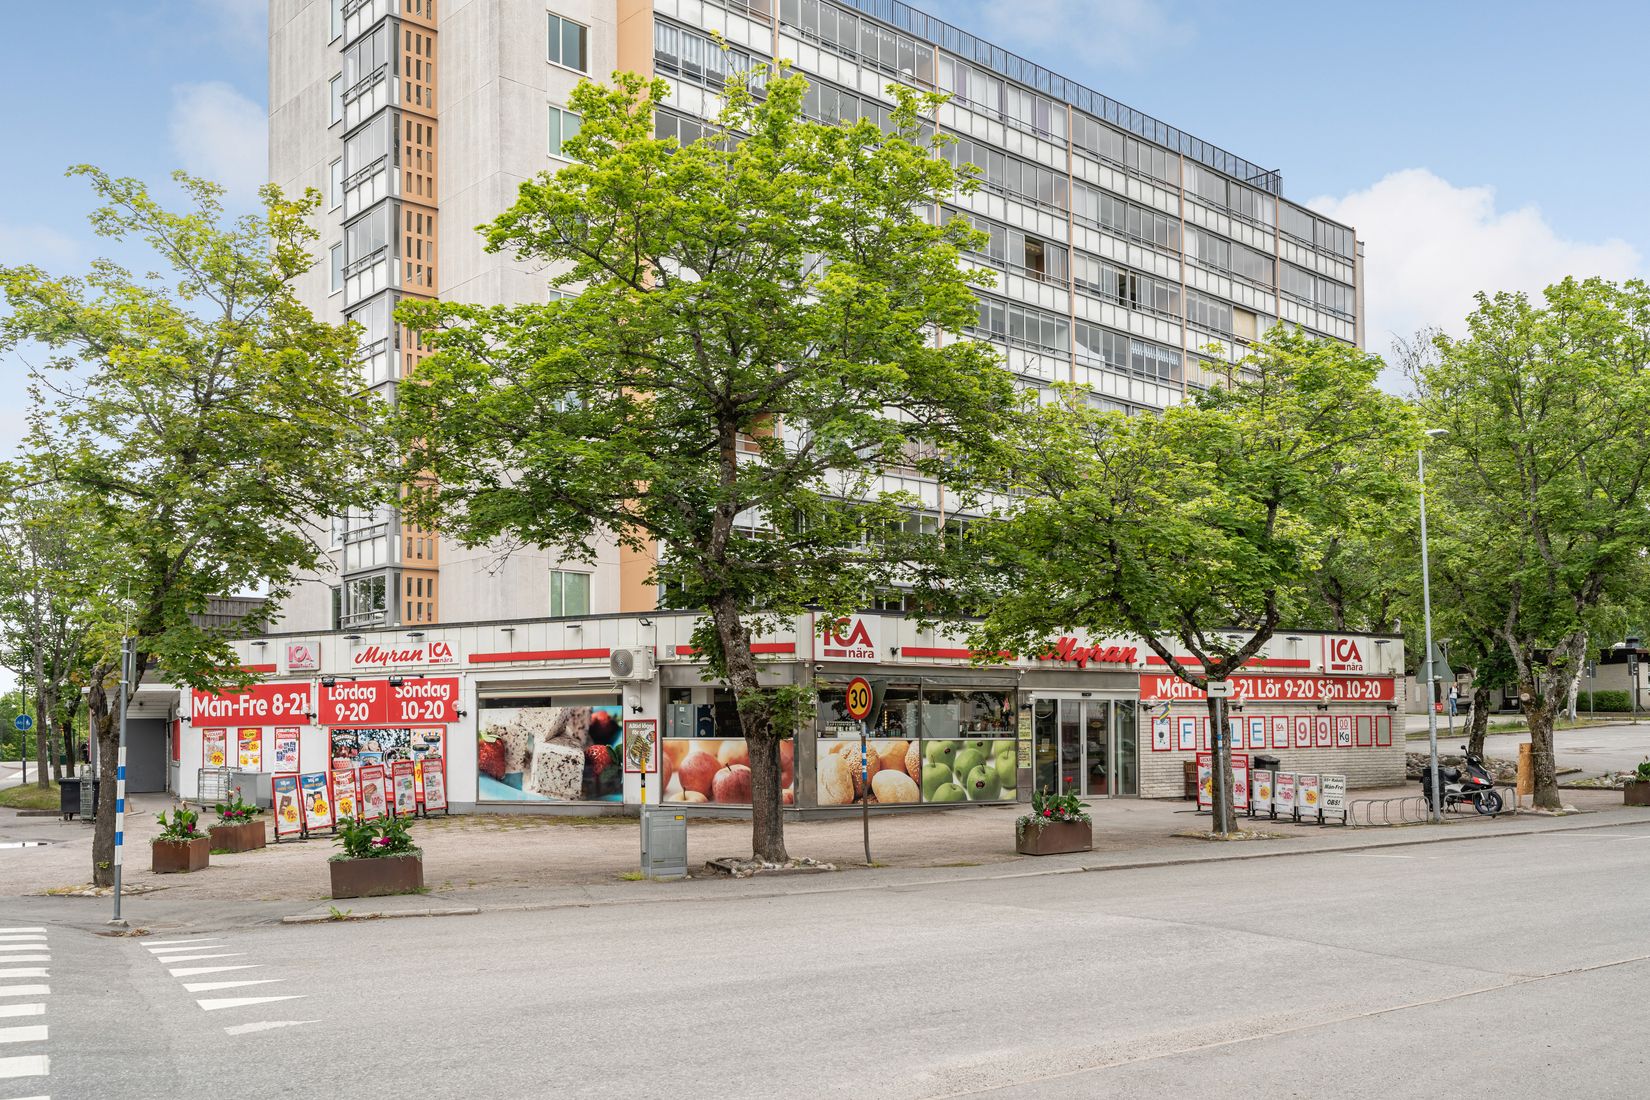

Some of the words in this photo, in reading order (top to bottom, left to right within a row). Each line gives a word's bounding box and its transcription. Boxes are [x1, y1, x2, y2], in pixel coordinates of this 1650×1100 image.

[824, 617, 874, 648] ICA
[288, 646, 313, 663] ICA
[354, 646, 423, 666] Myran
[429, 642, 453, 658] ICA
[439, 655, 453, 663] nära
[848, 647, 875, 659] nära
[1040, 636, 1138, 668] Myran
[1331, 639, 1362, 662] ICA
[1346, 661, 1363, 671] nära
[328, 684, 376, 703] Lördag
[394, 681, 450, 701] Söndag
[850, 688, 868, 708] 30
[1257, 679, 1281, 698] Lör
[1284, 679, 1315, 698] 9-20
[1317, 680, 1343, 698] Sön
[1347, 681, 1381, 698] 10-20
[193, 694, 268, 717] Mån-Fre
[272, 692, 307, 716] 8-21
[335, 703, 369, 721] 9-20
[401, 700, 445, 720] 10-20
[1339, 731, 1350, 743] Kg
